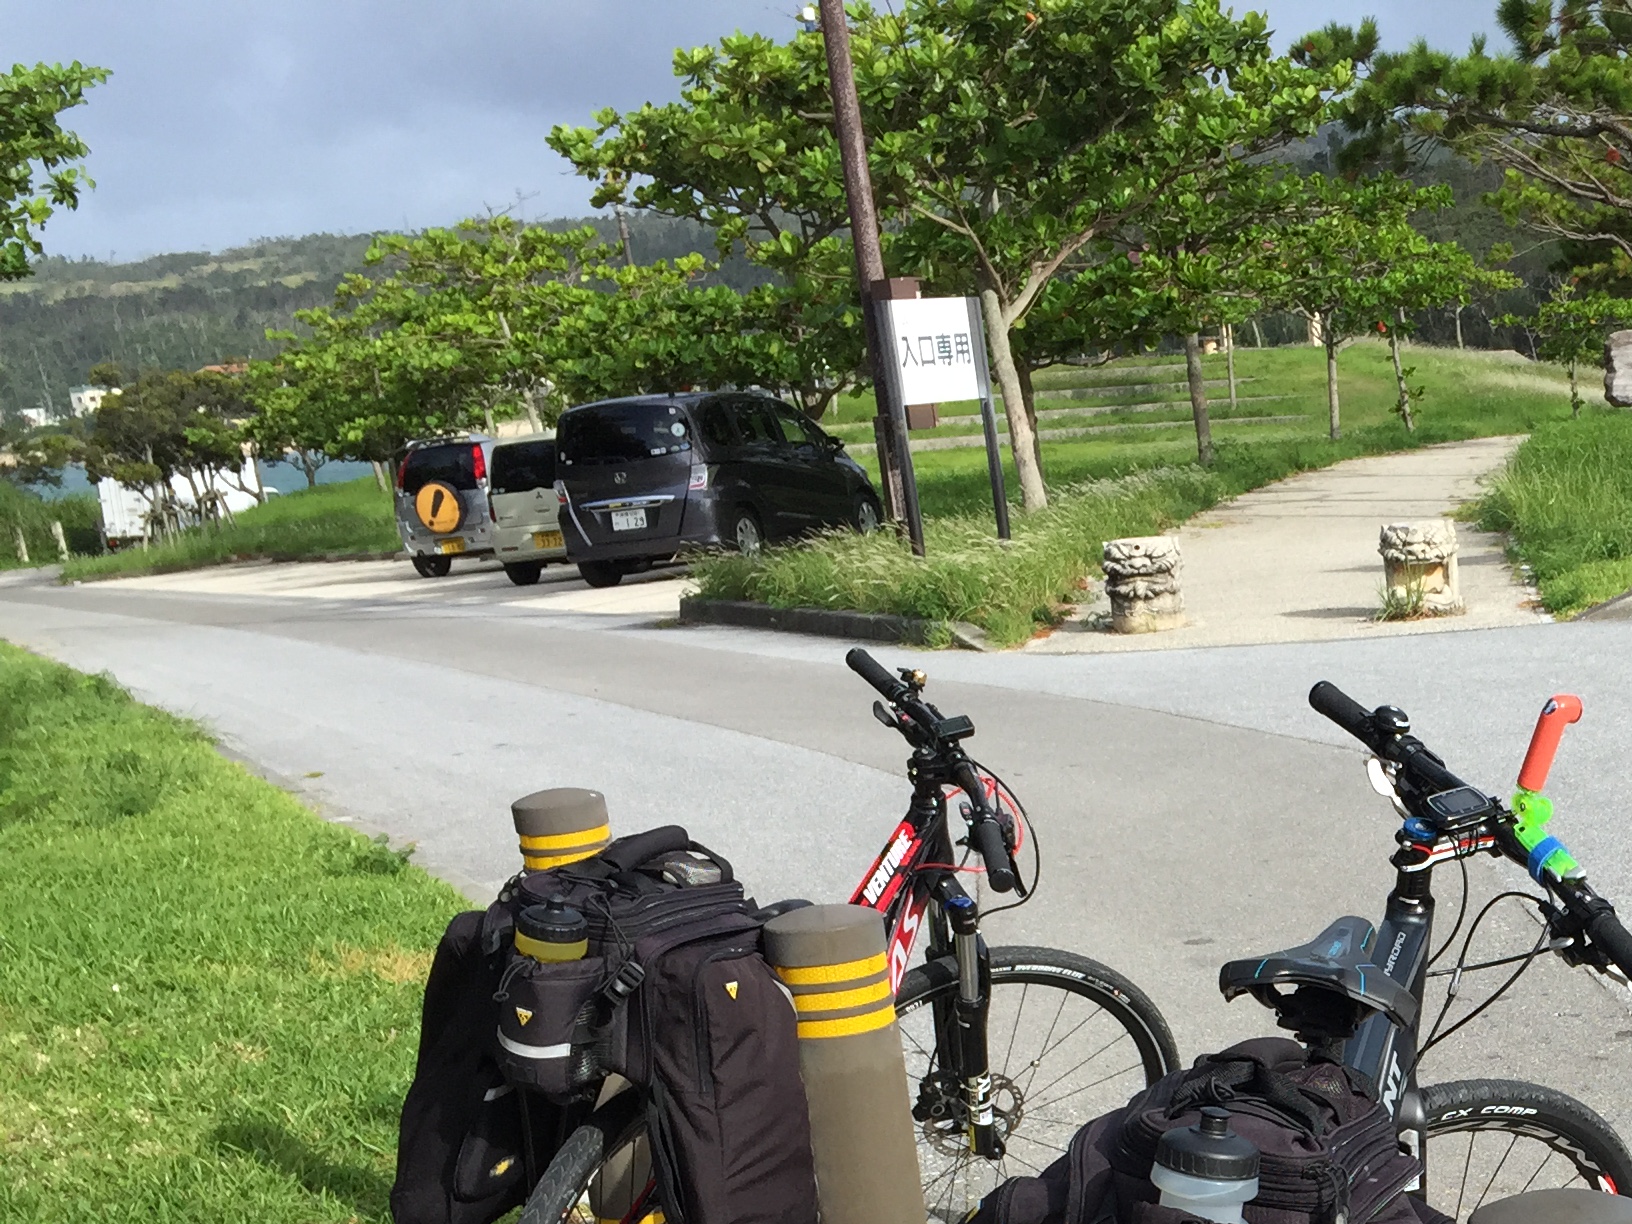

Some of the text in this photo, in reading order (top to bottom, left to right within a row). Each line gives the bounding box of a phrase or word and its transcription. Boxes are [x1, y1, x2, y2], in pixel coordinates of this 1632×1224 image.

[901, 332, 972, 368] 入口専用
[863, 829, 912, 905] VENTURE
[1440, 1105, 1539, 1121] CX COMP
